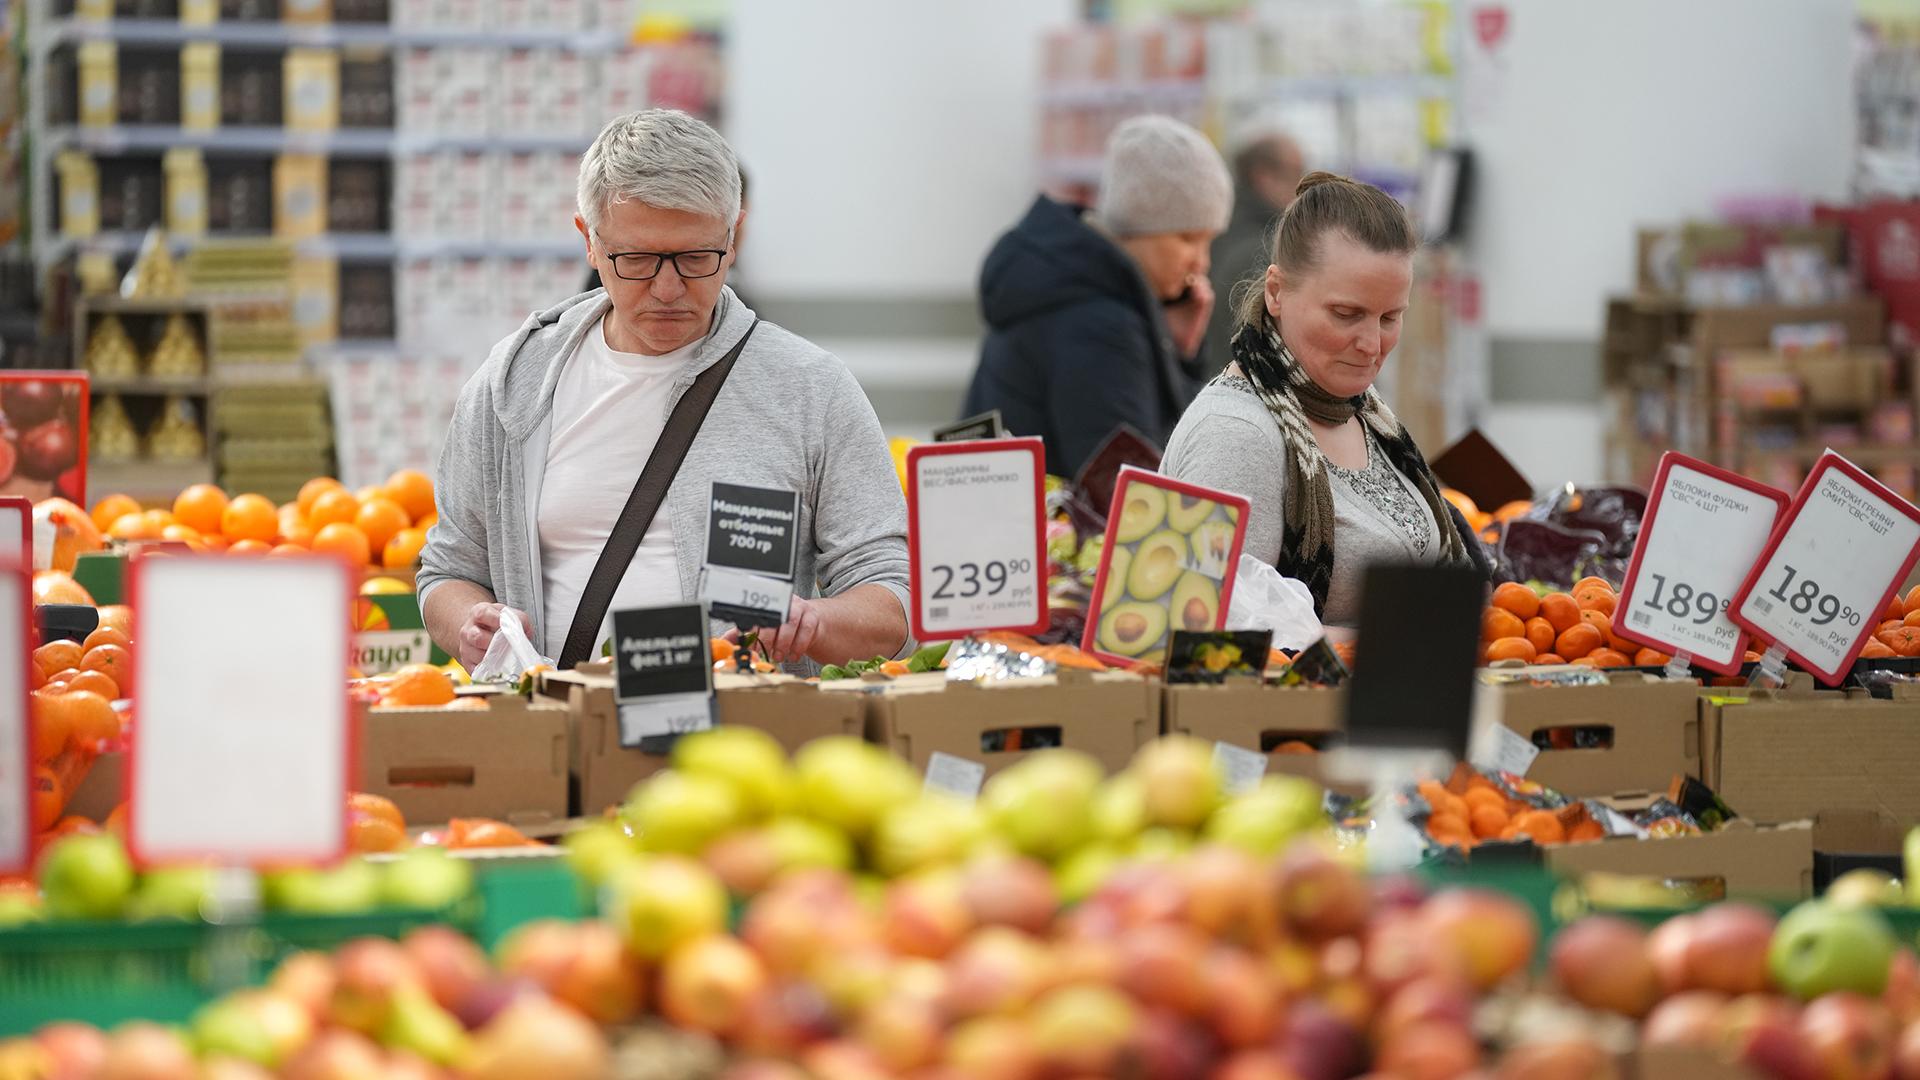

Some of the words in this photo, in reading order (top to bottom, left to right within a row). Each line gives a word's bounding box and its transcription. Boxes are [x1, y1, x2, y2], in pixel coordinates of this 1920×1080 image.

[923, 464, 990, 476] МАНДАРИНЫ
[971, 473, 1019, 484] МАРОККО
[1672, 479, 1711, 498] ЯБЛОКИ
[1713, 493, 1749, 513] ФУДЖИ
[1821, 488, 1847, 508] СМИТ
[1826, 478, 1862, 506] ЯБЛОКИ
[1861, 500, 1896, 528] ГРЕННИ
[712, 499, 794, 521] Мандарины
[1695, 500, 1702, 508] 4
[1702, 503, 1720, 513] ШТ
[718, 518, 786, 537] отборные
[729, 533, 756, 549] 700
[757, 538, 773, 554] гр
[1714, 625, 1736, 640] руб
[1828, 631, 1849, 646] руб
[621, 635, 701, 651] Апельсин
[664, 650, 673, 665] 1
